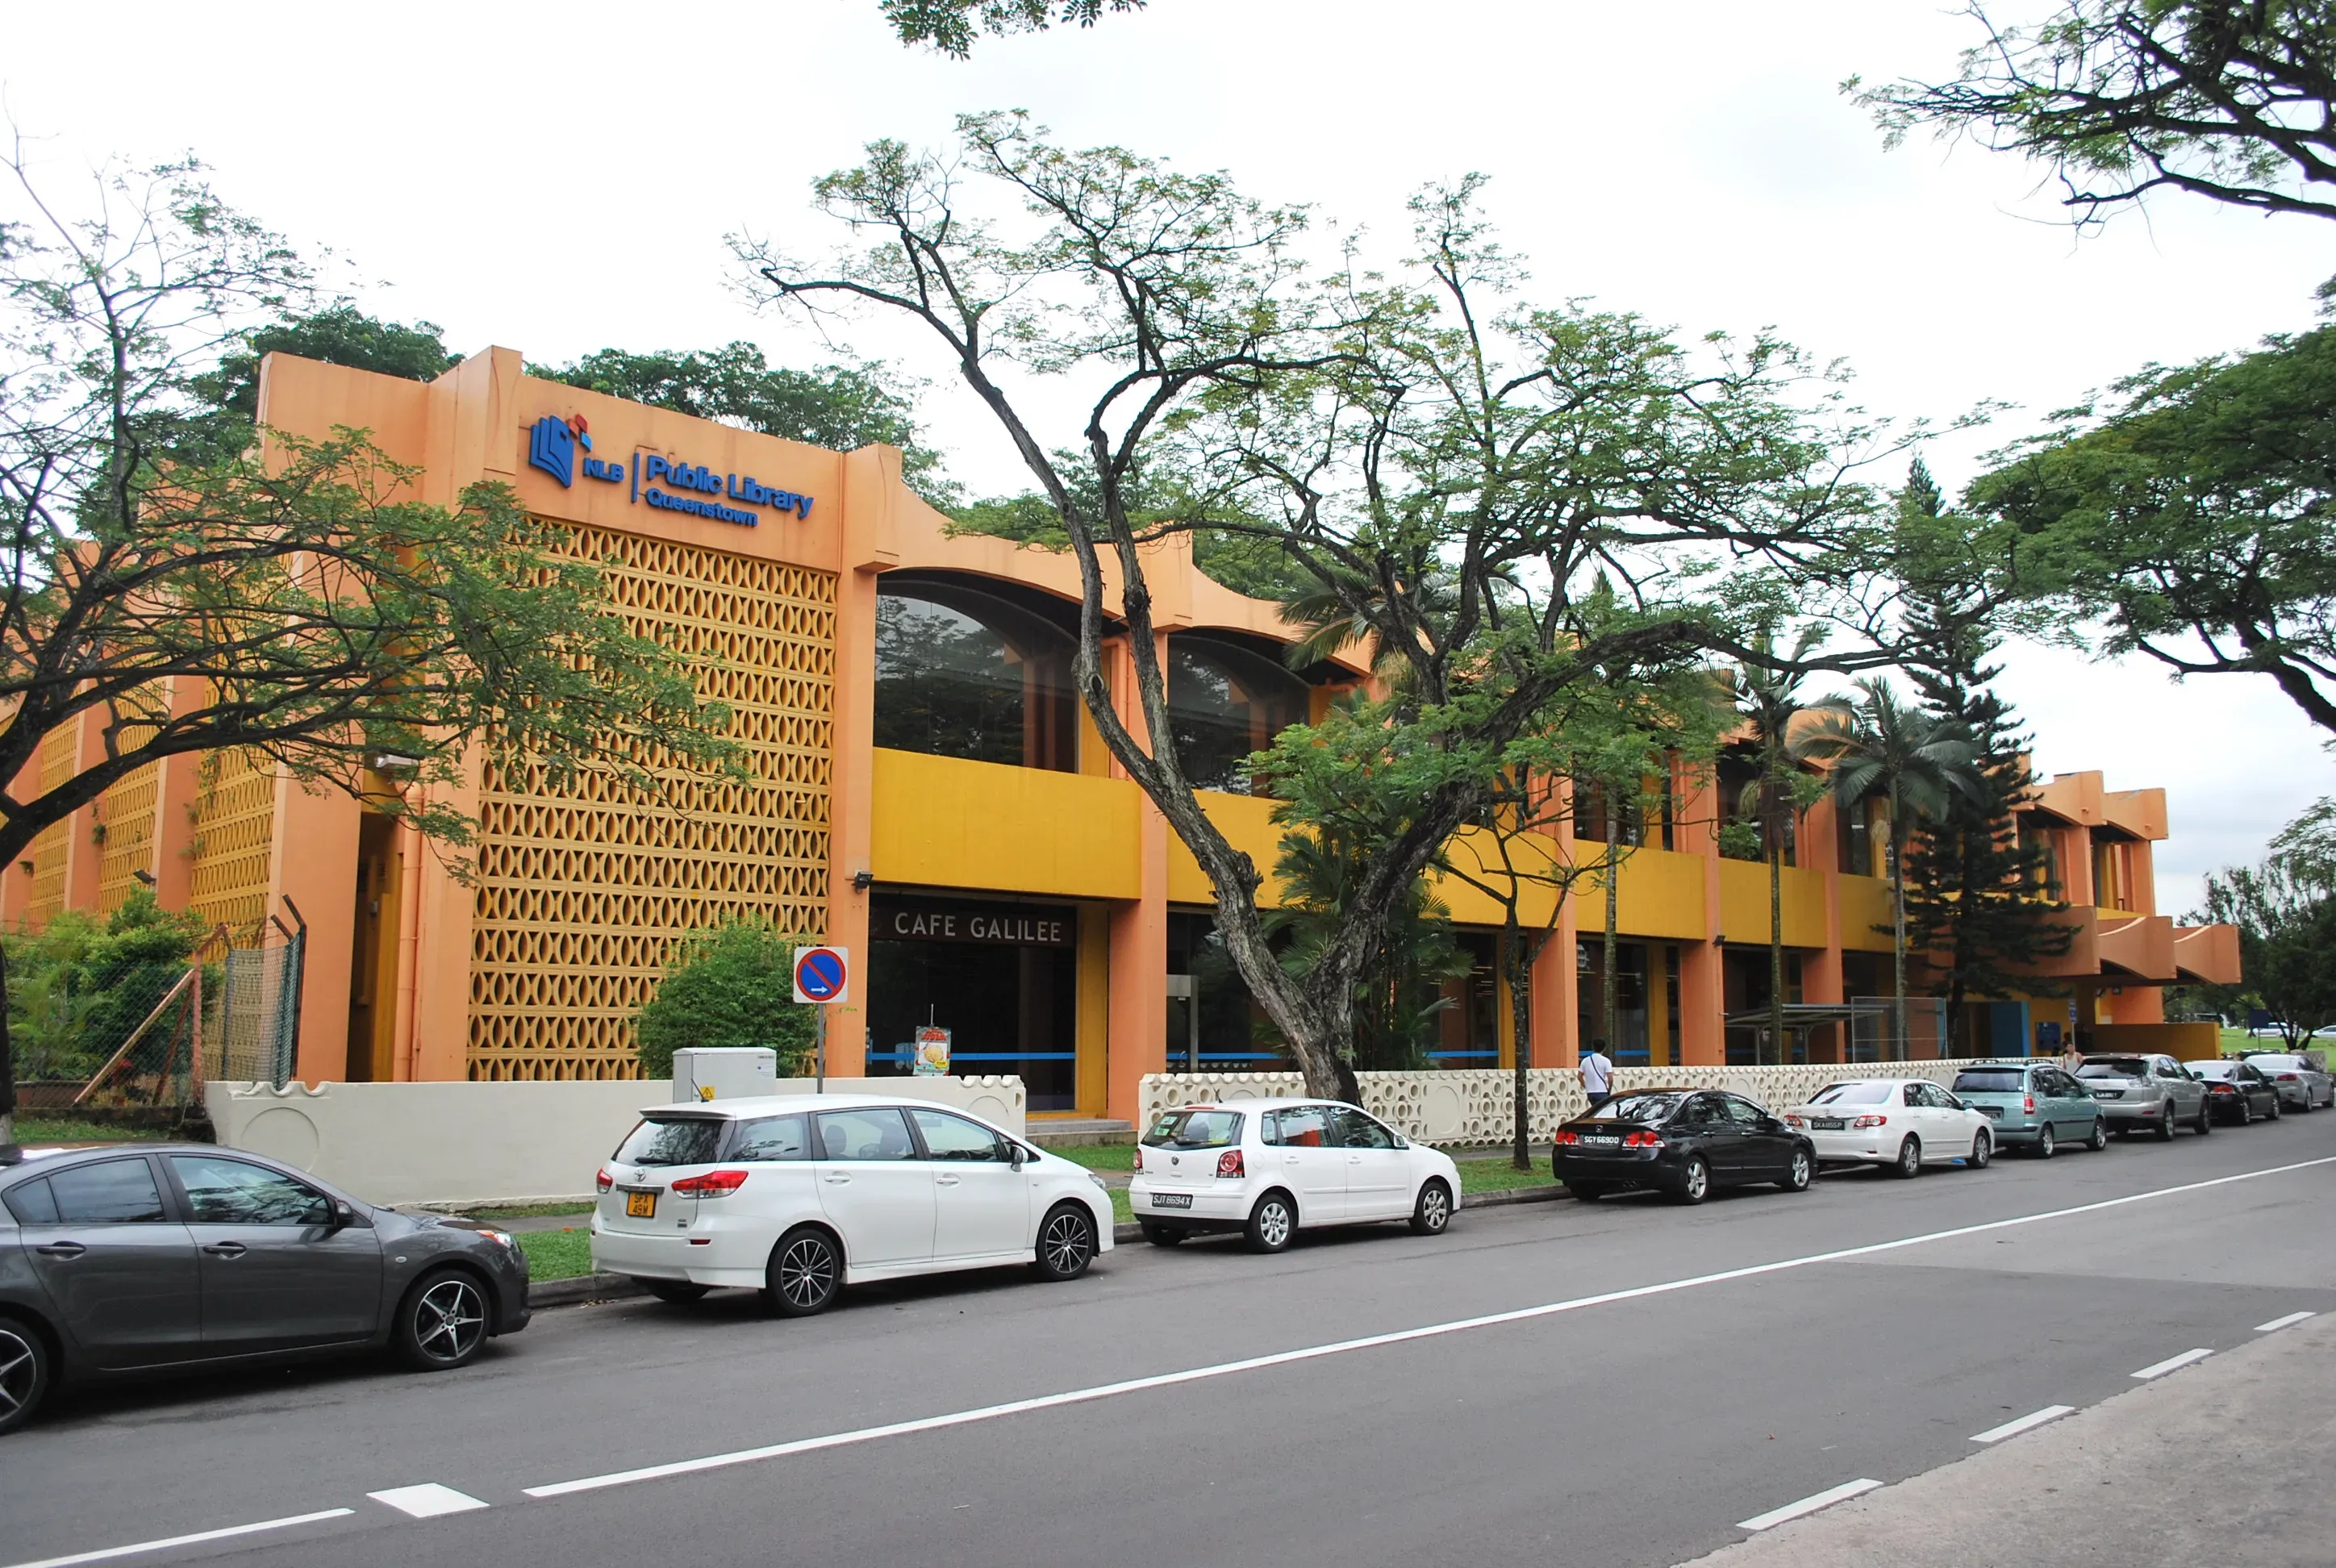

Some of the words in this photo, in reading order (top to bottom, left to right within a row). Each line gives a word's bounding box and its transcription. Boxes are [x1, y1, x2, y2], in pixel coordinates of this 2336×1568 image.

[582, 457, 624, 482] NLB
[647, 455, 723, 494] Public
[728, 473, 814, 519] Library
[646, 488, 758, 527] Queenstown
[895, 912, 956, 936] CAFE
[970, 917, 1061, 941] GALILEE
[1153, 1195, 1191, 1205] SJT8694X
